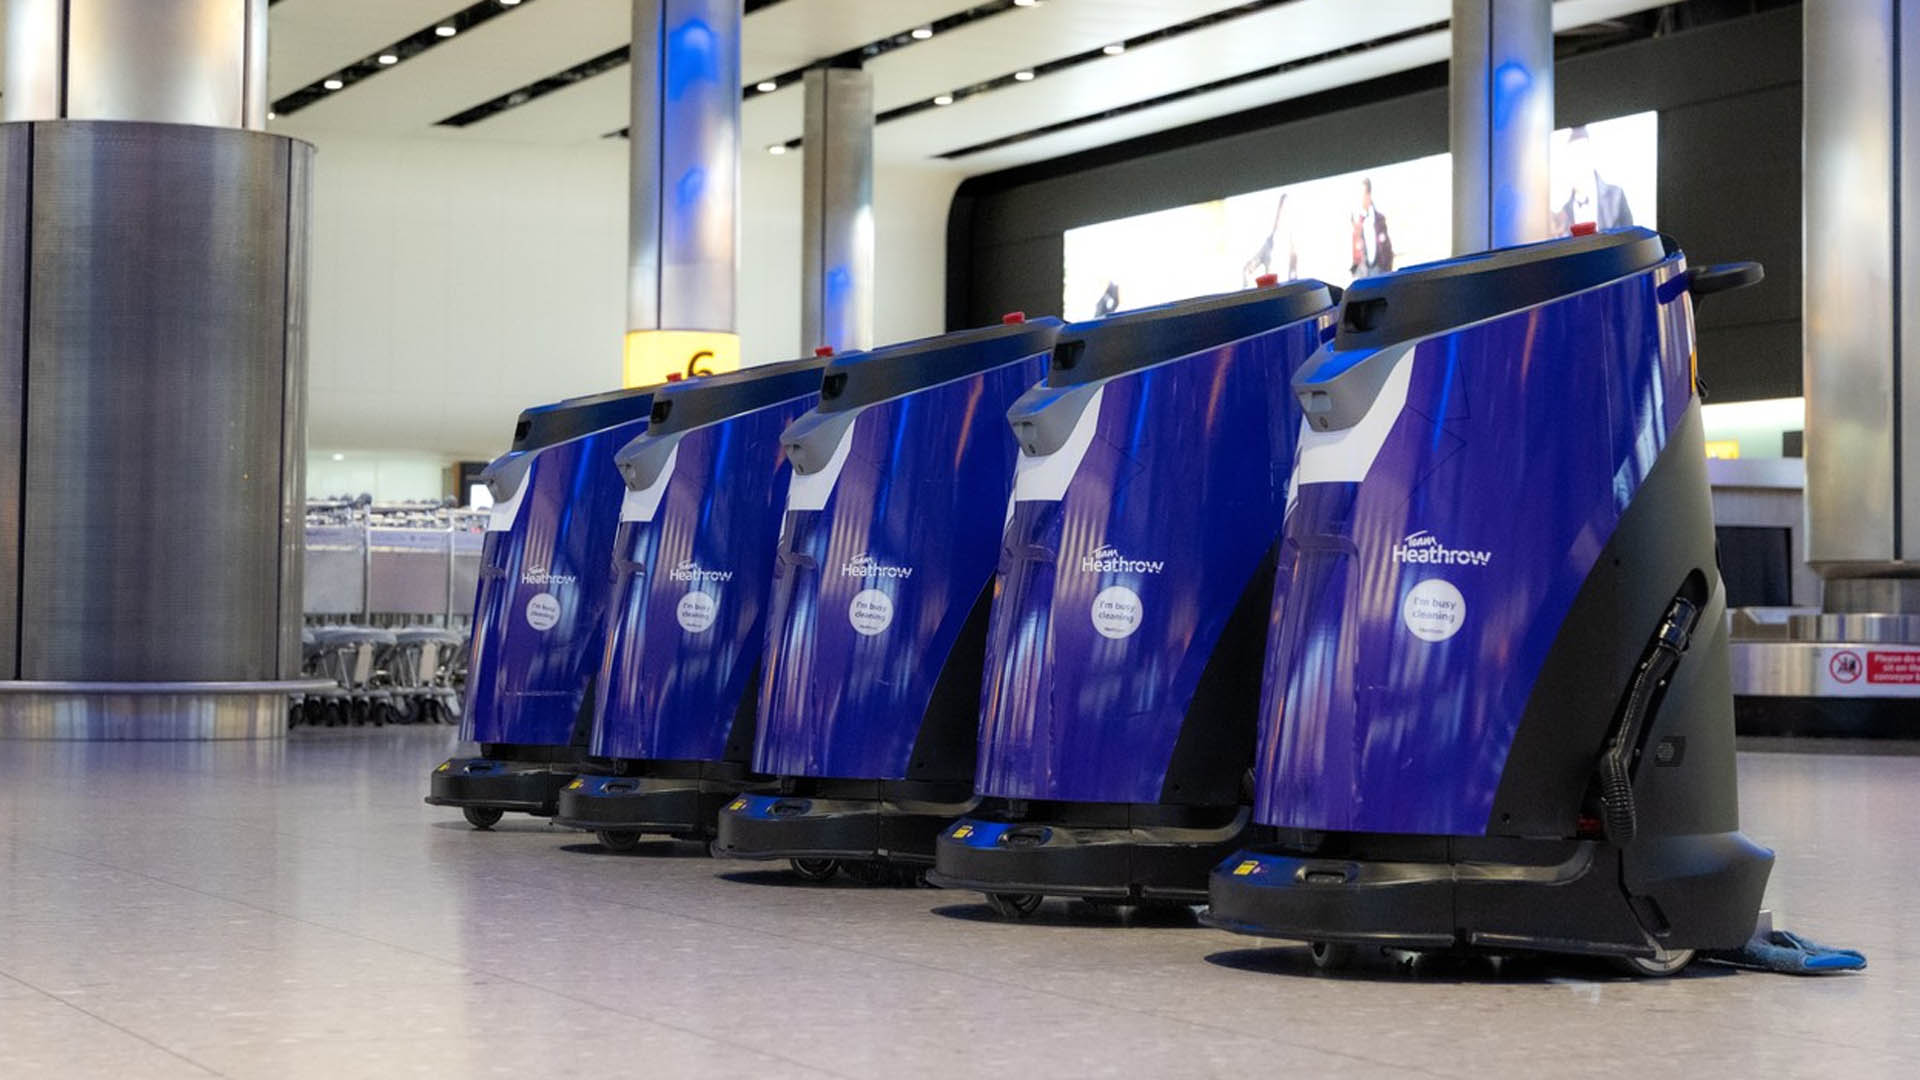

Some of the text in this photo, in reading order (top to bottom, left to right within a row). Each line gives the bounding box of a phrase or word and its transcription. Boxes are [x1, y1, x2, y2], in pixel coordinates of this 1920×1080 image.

[687, 350, 714, 377] 6
[1393, 544, 1491, 566] Heathrow
[841, 563, 912, 578] Heathrow
[1082, 556, 1164, 573] Heathrow
[521, 573, 576, 584] Heathrow
[670, 568, 733, 581] Heathrow
